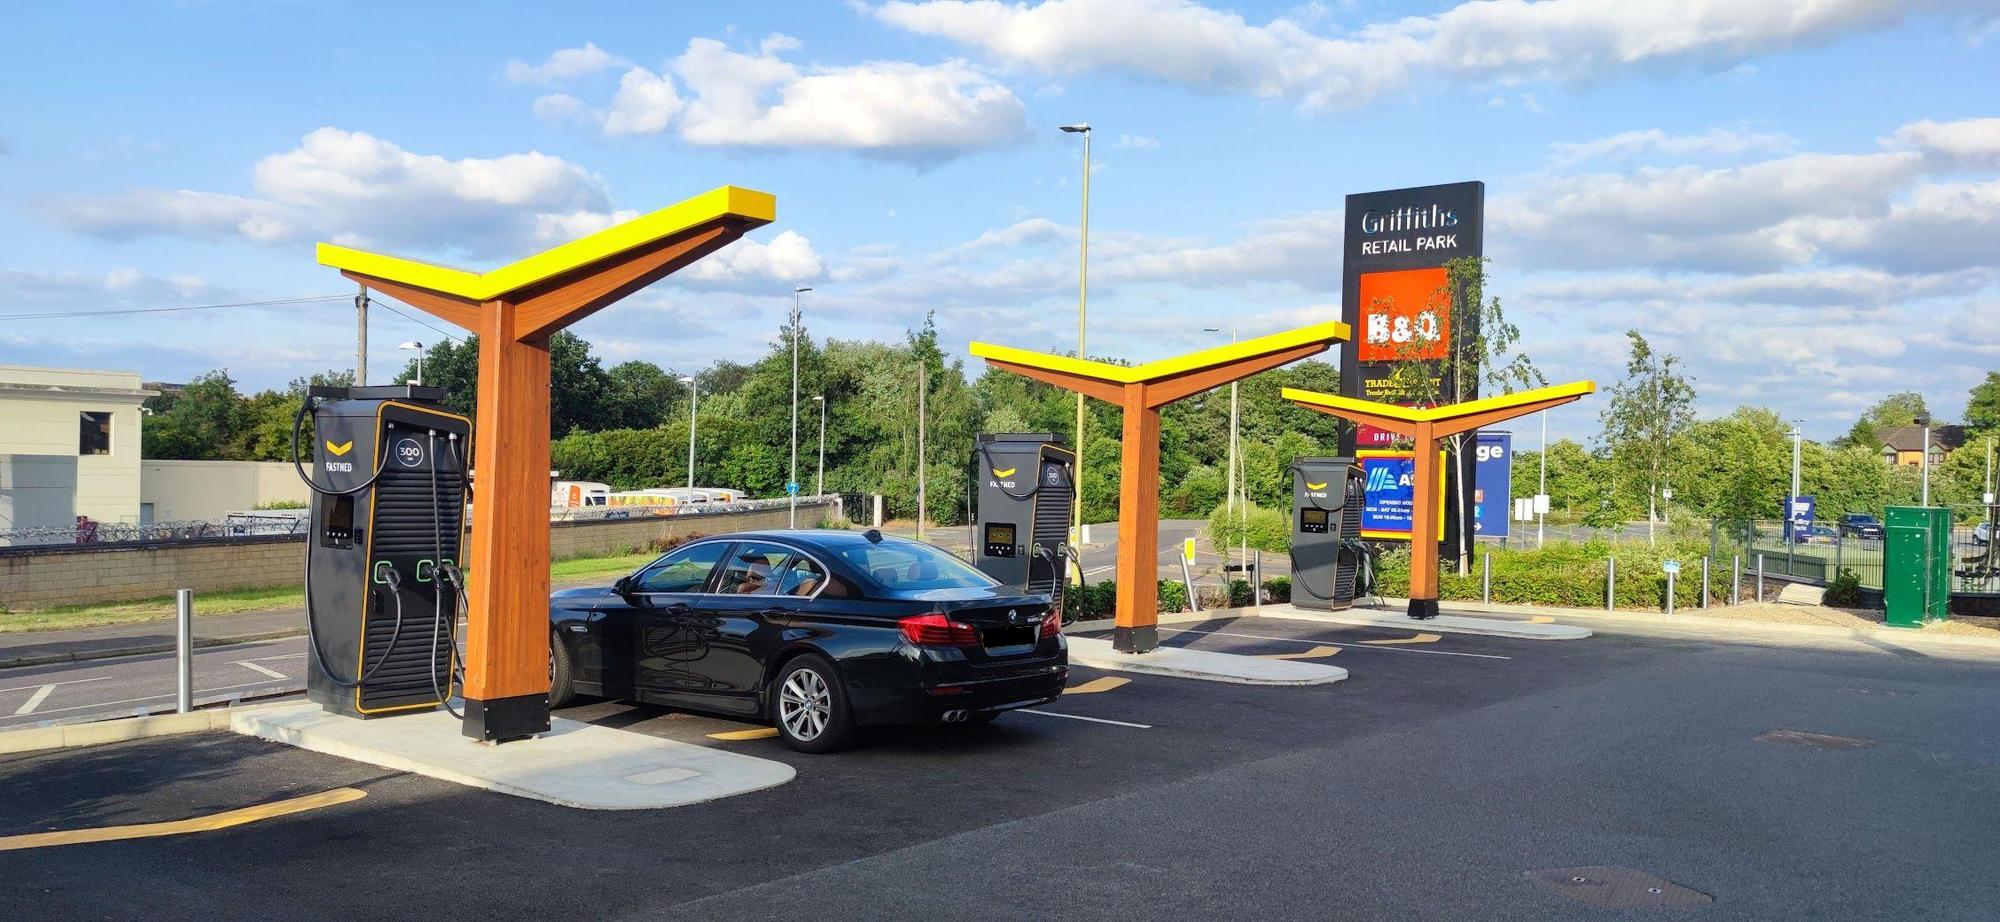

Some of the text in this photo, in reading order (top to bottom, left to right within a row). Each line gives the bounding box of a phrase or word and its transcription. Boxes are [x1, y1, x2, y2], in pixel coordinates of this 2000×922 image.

[1362, 204, 1458, 235] Griffiths
[1362, 234, 1457, 255] RETAIL PARK
[1367, 310, 1441, 344] B&Q
[400, 447, 420, 457] 300
[325, 461, 353, 472] FASTNED
[989, 480, 1016, 488] FATNED
